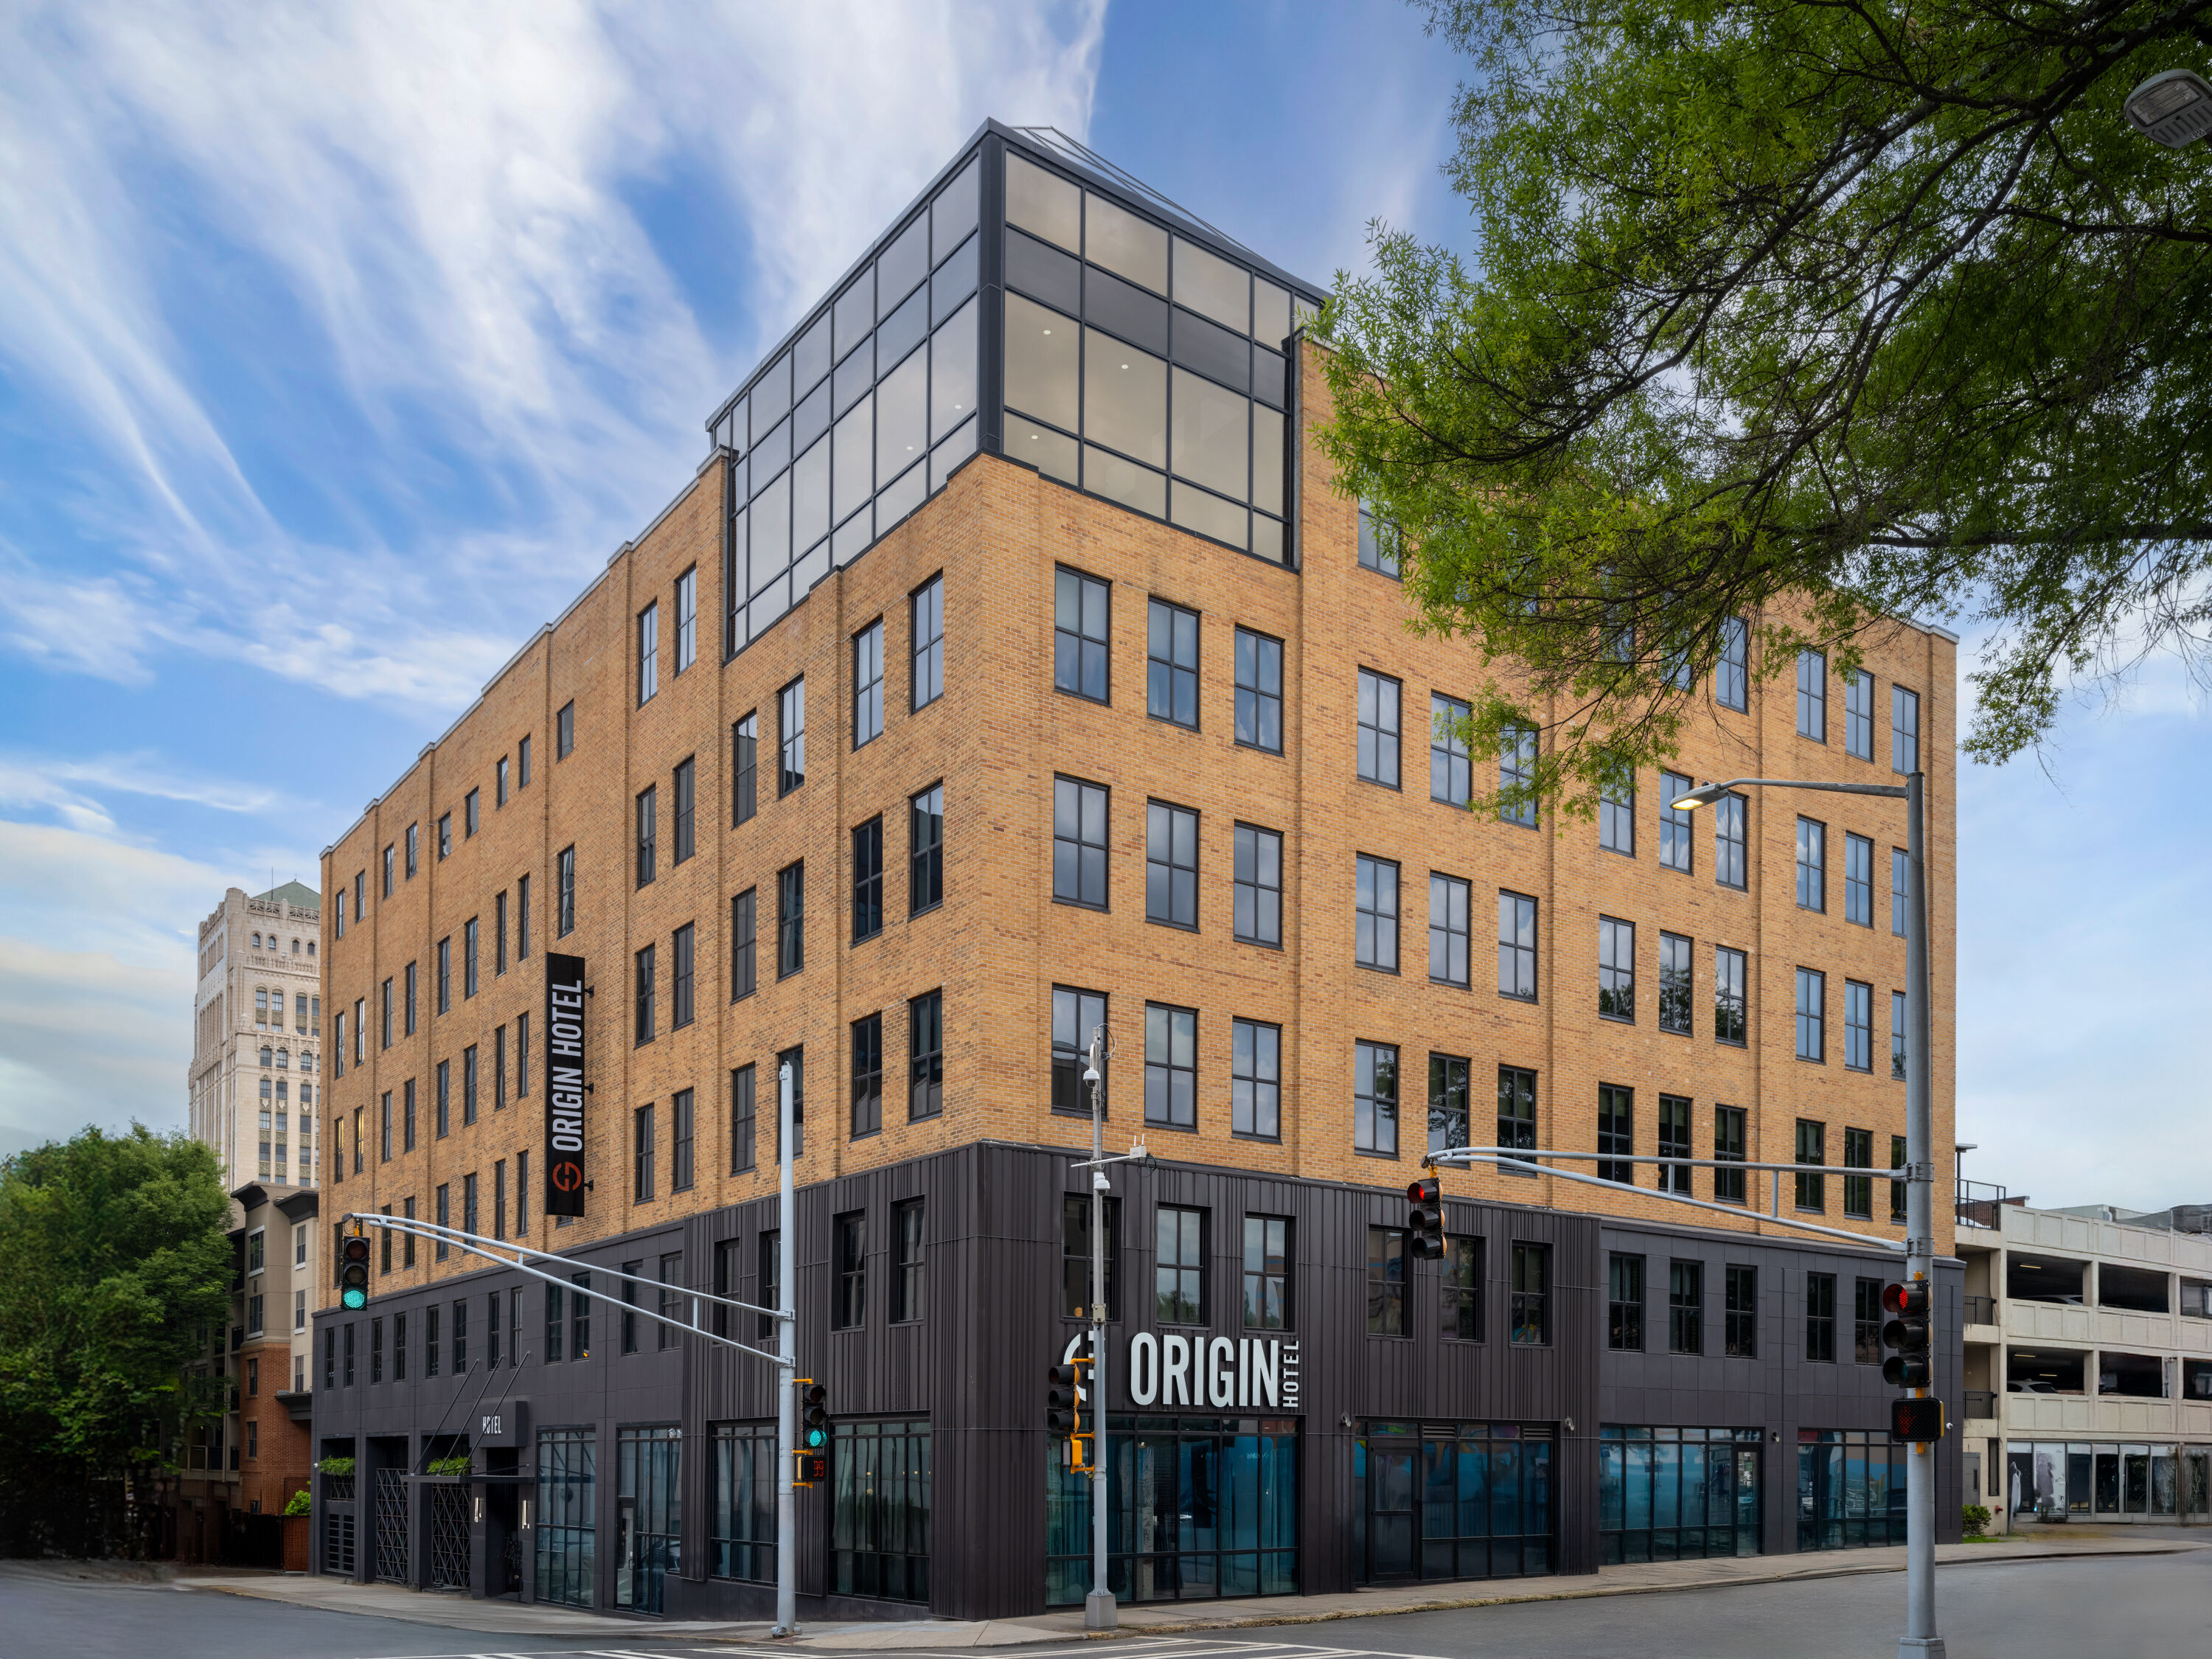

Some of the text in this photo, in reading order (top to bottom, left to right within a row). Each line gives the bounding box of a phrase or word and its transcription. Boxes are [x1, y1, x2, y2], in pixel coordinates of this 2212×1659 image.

[552, 980, 582, 1152] ORIGIN HOTEL
[1130, 1332, 1279, 1408] ORIGIN
[1282, 1340, 1299, 1408] HOTEL
[482, 1415, 502, 1434] HOTEL
